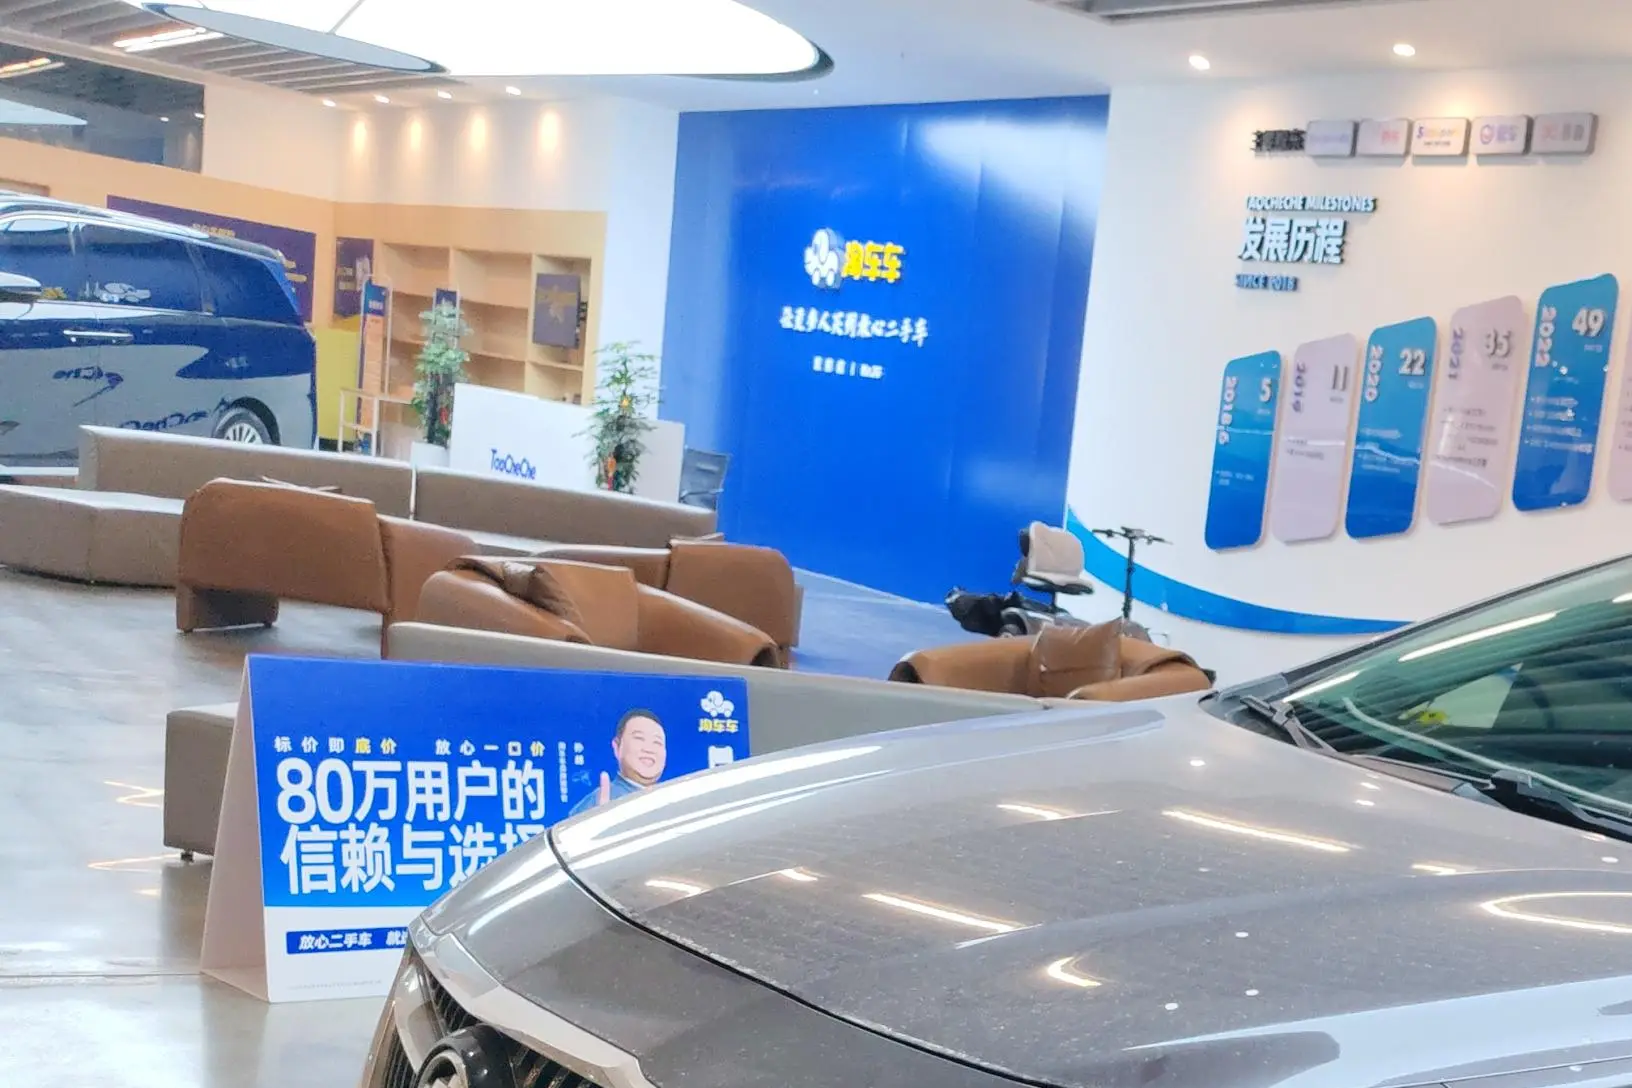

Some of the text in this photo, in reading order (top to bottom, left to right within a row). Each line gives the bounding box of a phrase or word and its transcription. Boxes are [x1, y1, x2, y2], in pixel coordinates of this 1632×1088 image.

[1239, 215, 1347, 264] 发展历程
[842, 240, 905, 283] 淘车车
[1534, 305, 1557, 367] 2022
[1572, 307, 1605, 337] 49
[1399, 348, 1427, 376] 22
[1448, 327, 1464, 380] 2021
[1259, 377, 1273, 403] 5
[1331, 365, 1349, 391] 11
[1364, 344, 1384, 402] 2020
[274, 736, 545, 757] 标价即底价 放心一口价
[276, 757, 547, 824] 80万用户的
[299, 932, 373, 951] 放心二手车
